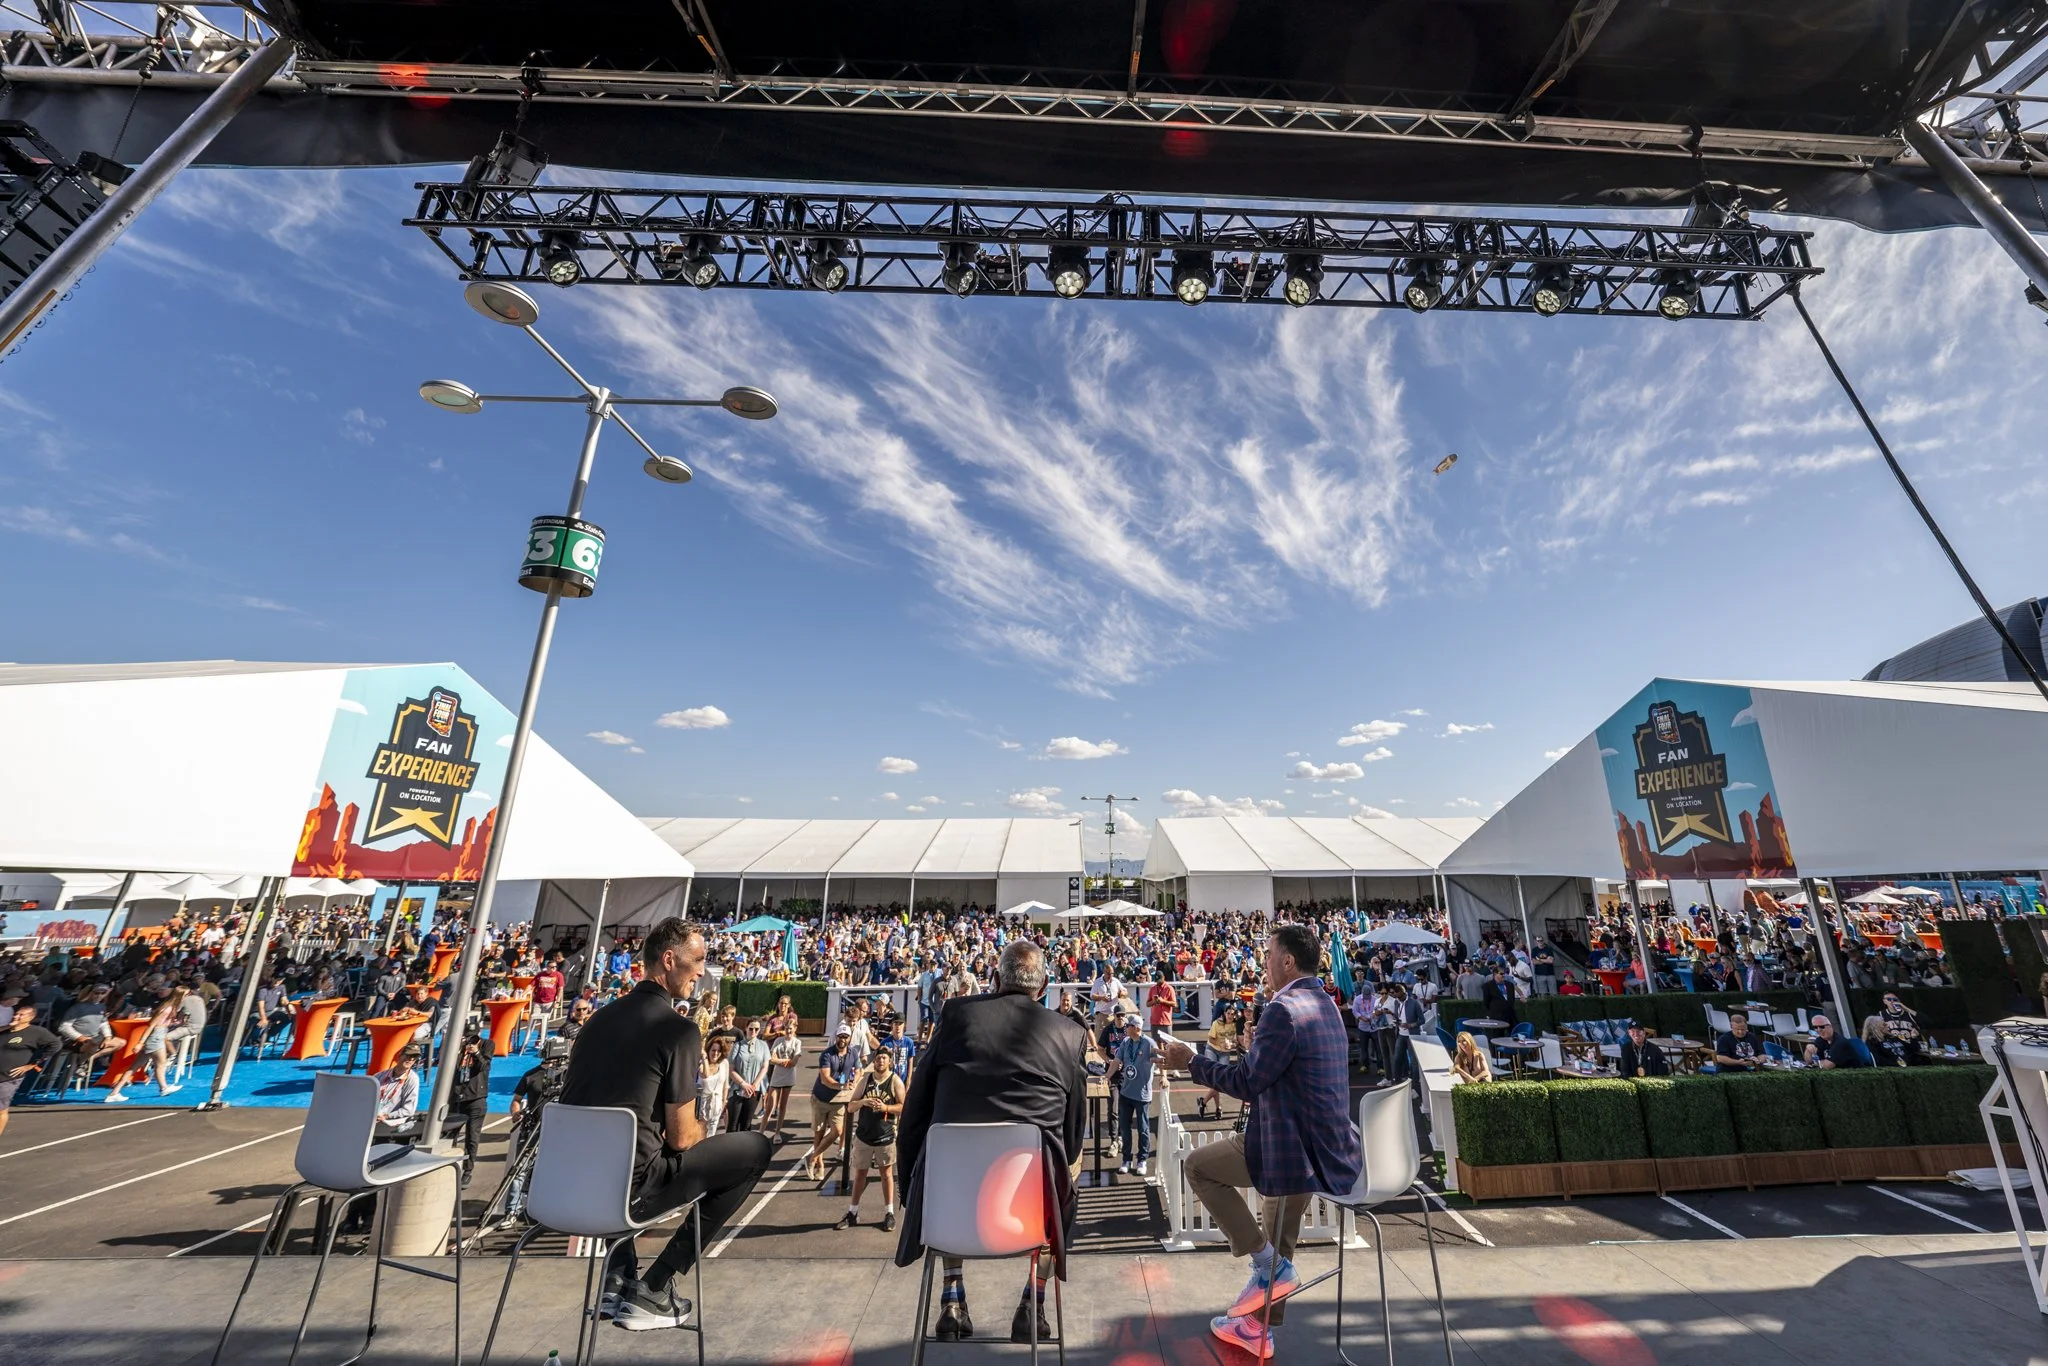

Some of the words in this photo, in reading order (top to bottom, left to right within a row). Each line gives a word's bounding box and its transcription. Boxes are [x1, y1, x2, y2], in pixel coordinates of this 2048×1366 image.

[524, 531, 558, 561] 3
[572, 538, 603, 578] 6
[415, 737, 453, 755] FAN
[1658, 748, 1689, 764] FAN
[372, 749, 475, 788] EXPERIENCE
[1638, 760, 1725, 795] EXPERIENCE
[399, 791, 410, 799] ON
[411, 793, 442, 803] LOCATION
[409, 787, 429, 795] POWERED
[1675, 799, 1702, 808] LOCATION
